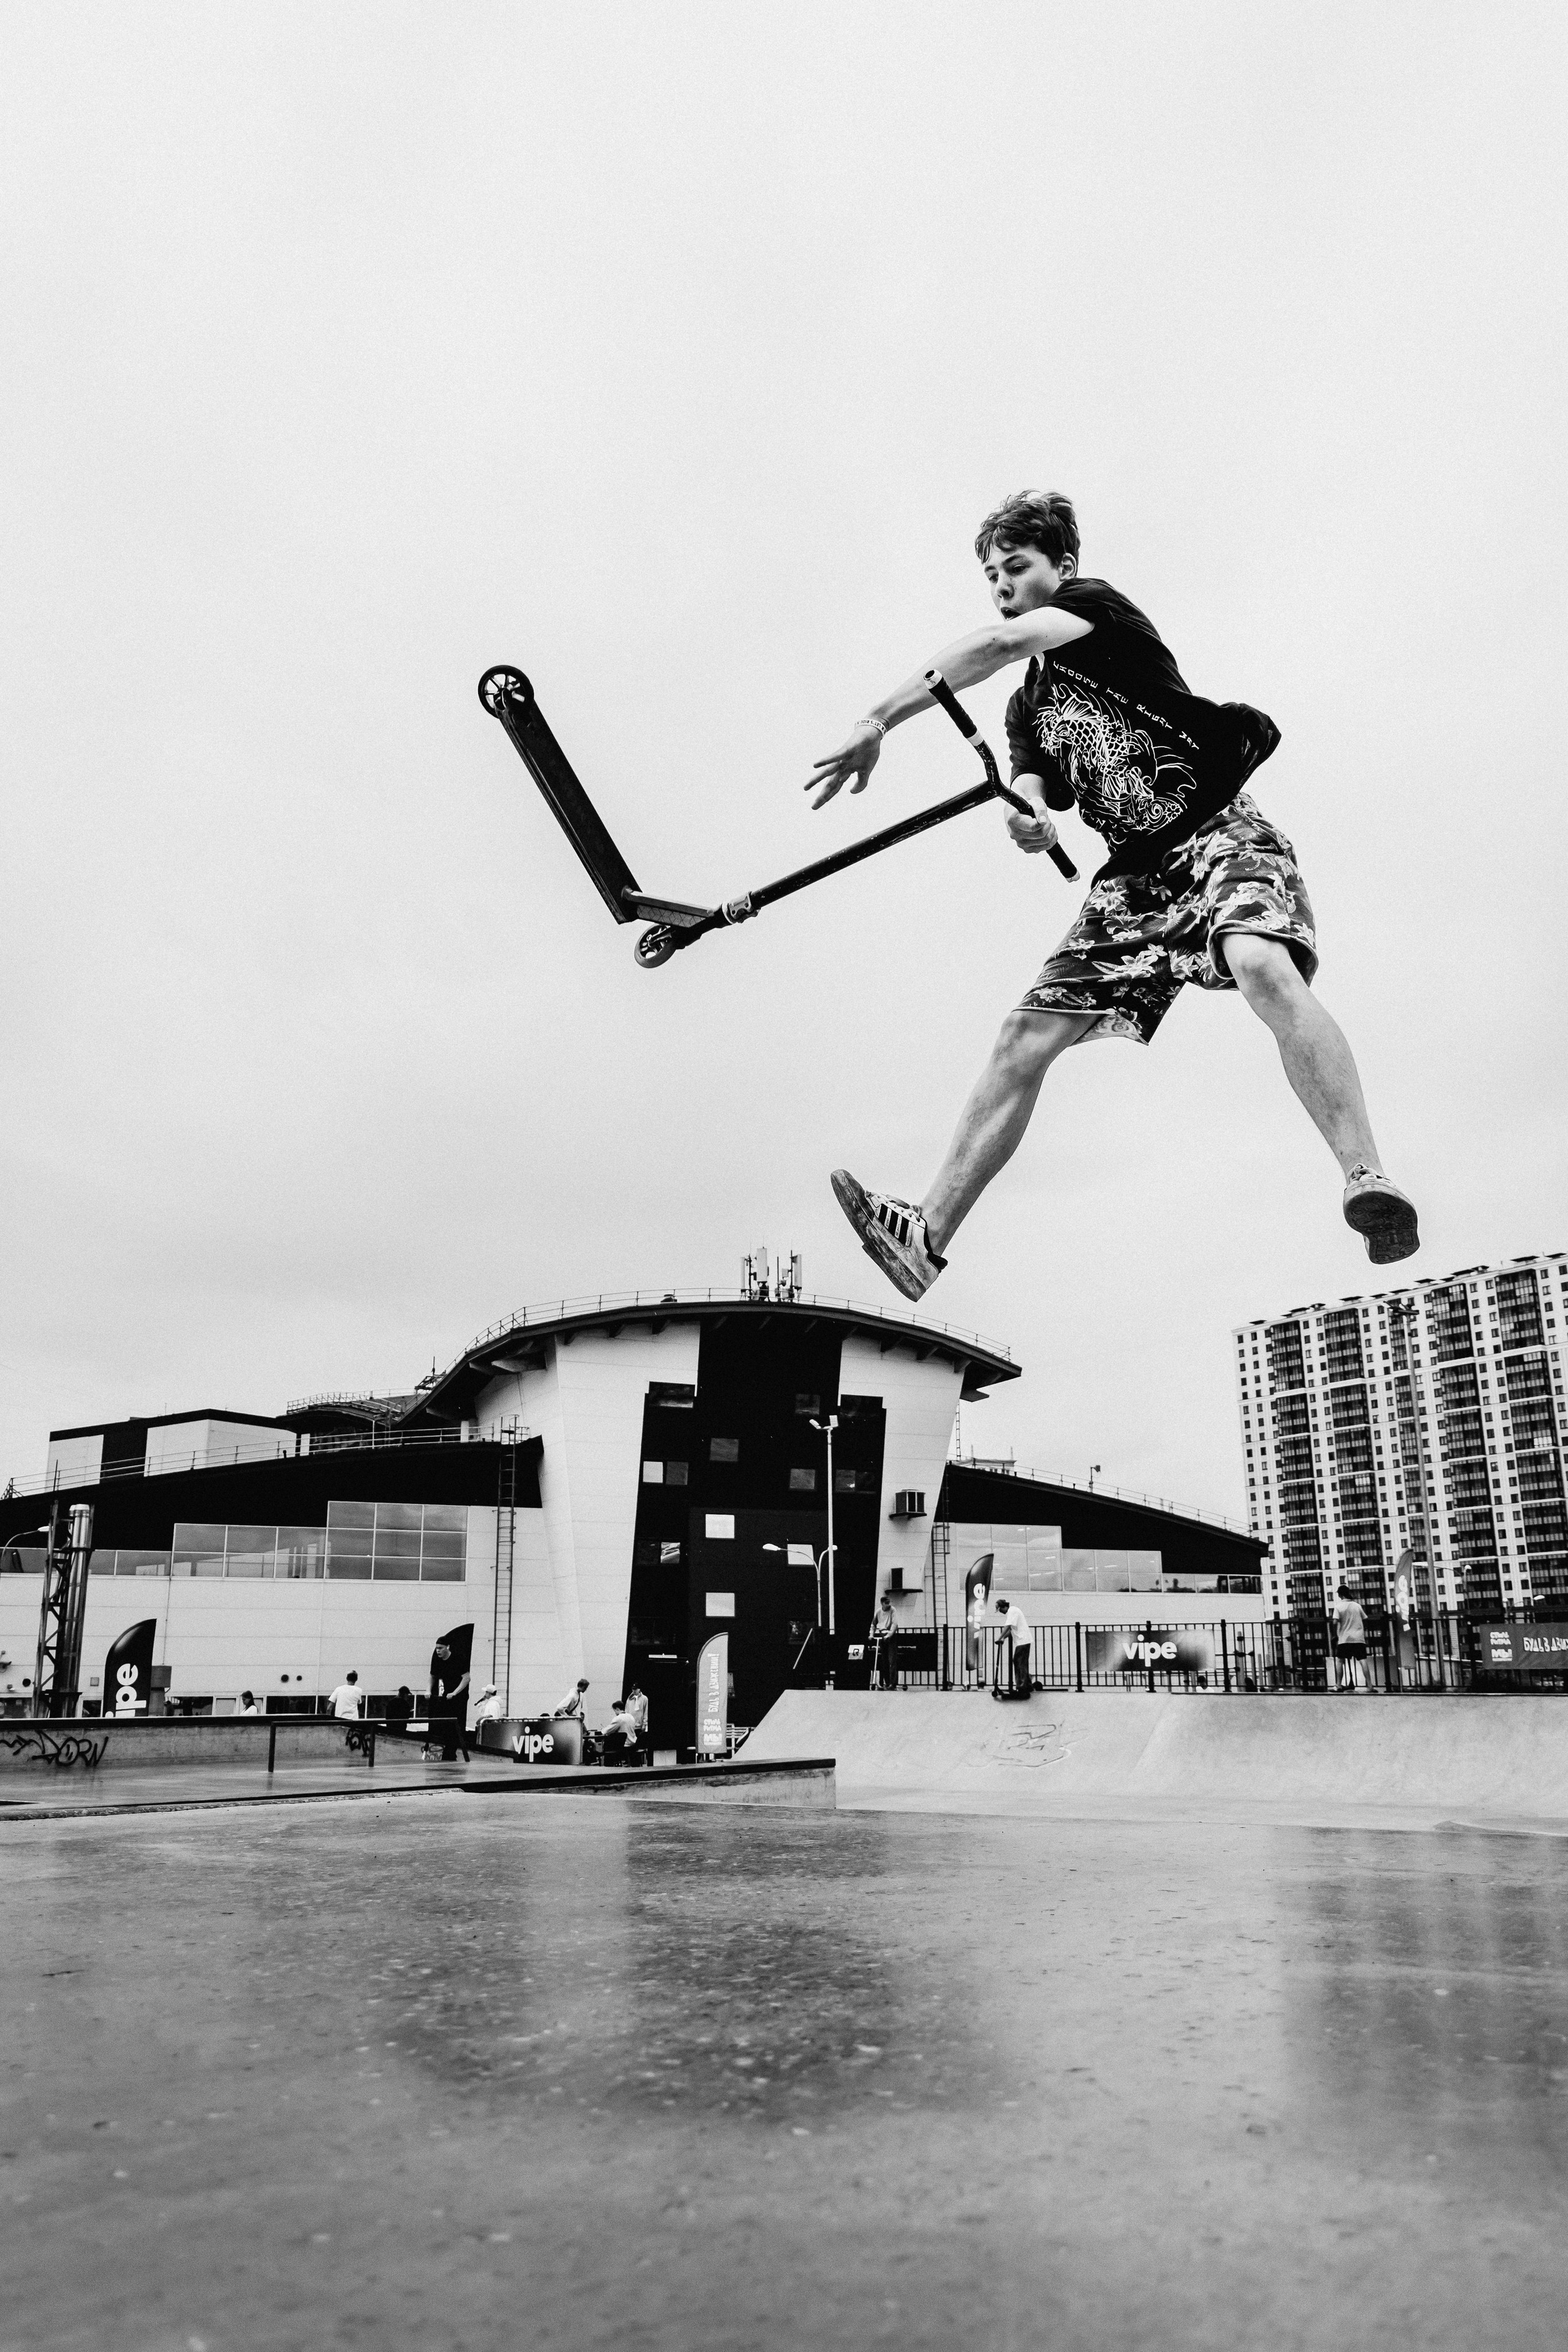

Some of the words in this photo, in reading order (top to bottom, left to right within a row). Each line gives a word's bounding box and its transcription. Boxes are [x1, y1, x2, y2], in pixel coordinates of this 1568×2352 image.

[1053, 660, 1098, 688] CHOOSE
[1106, 687, 1129, 704] THE
[1136, 704, 1173, 729] RIGHT
[1178, 731, 1200, 750] WAY
[1122, 1634, 1177, 1667] vipe
[1523, 1637, 1544, 1652] БУДЬ
[105, 1663, 147, 1717] ipe
[512, 1726, 554, 1762] vipe
